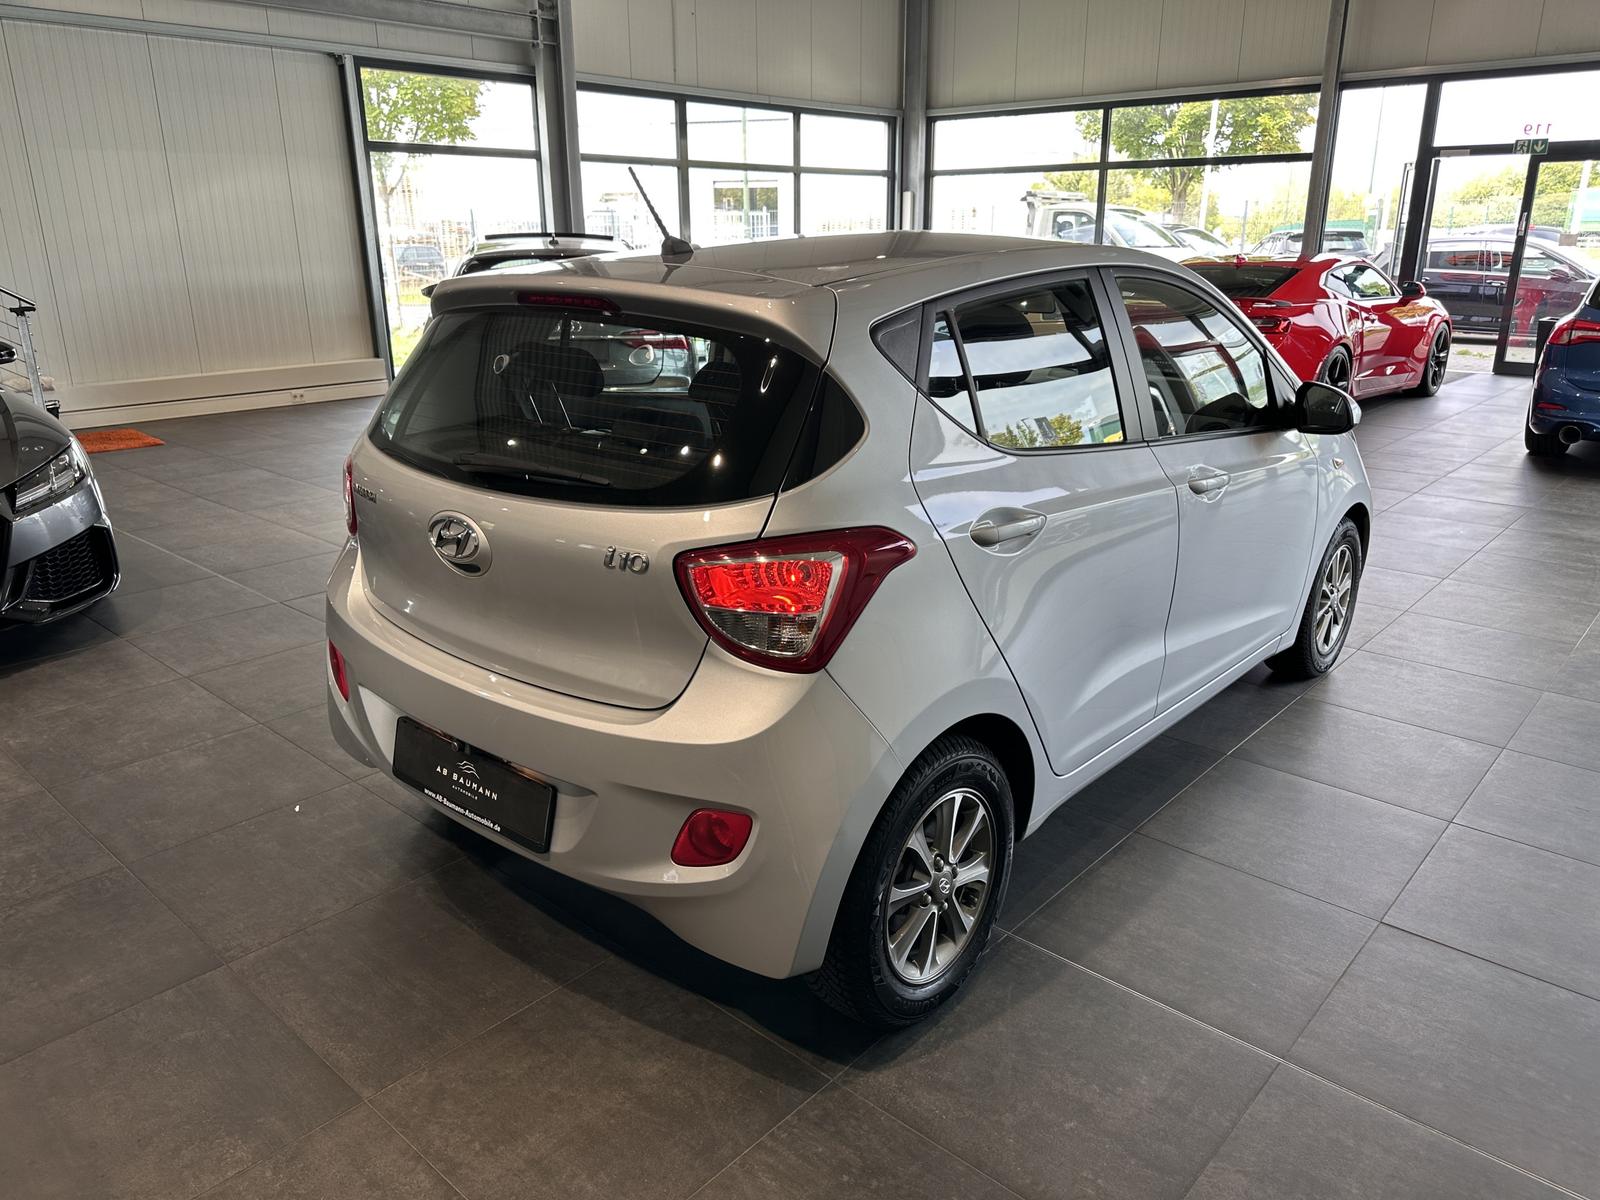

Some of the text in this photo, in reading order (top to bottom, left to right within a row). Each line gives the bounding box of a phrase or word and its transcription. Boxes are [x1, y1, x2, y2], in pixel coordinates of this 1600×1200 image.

[603, 545, 650, 575] i10
[436, 765, 498, 801] AB BAUMANN
[424, 788, 501, 832] www.AB-Baumann-Automobile.de
